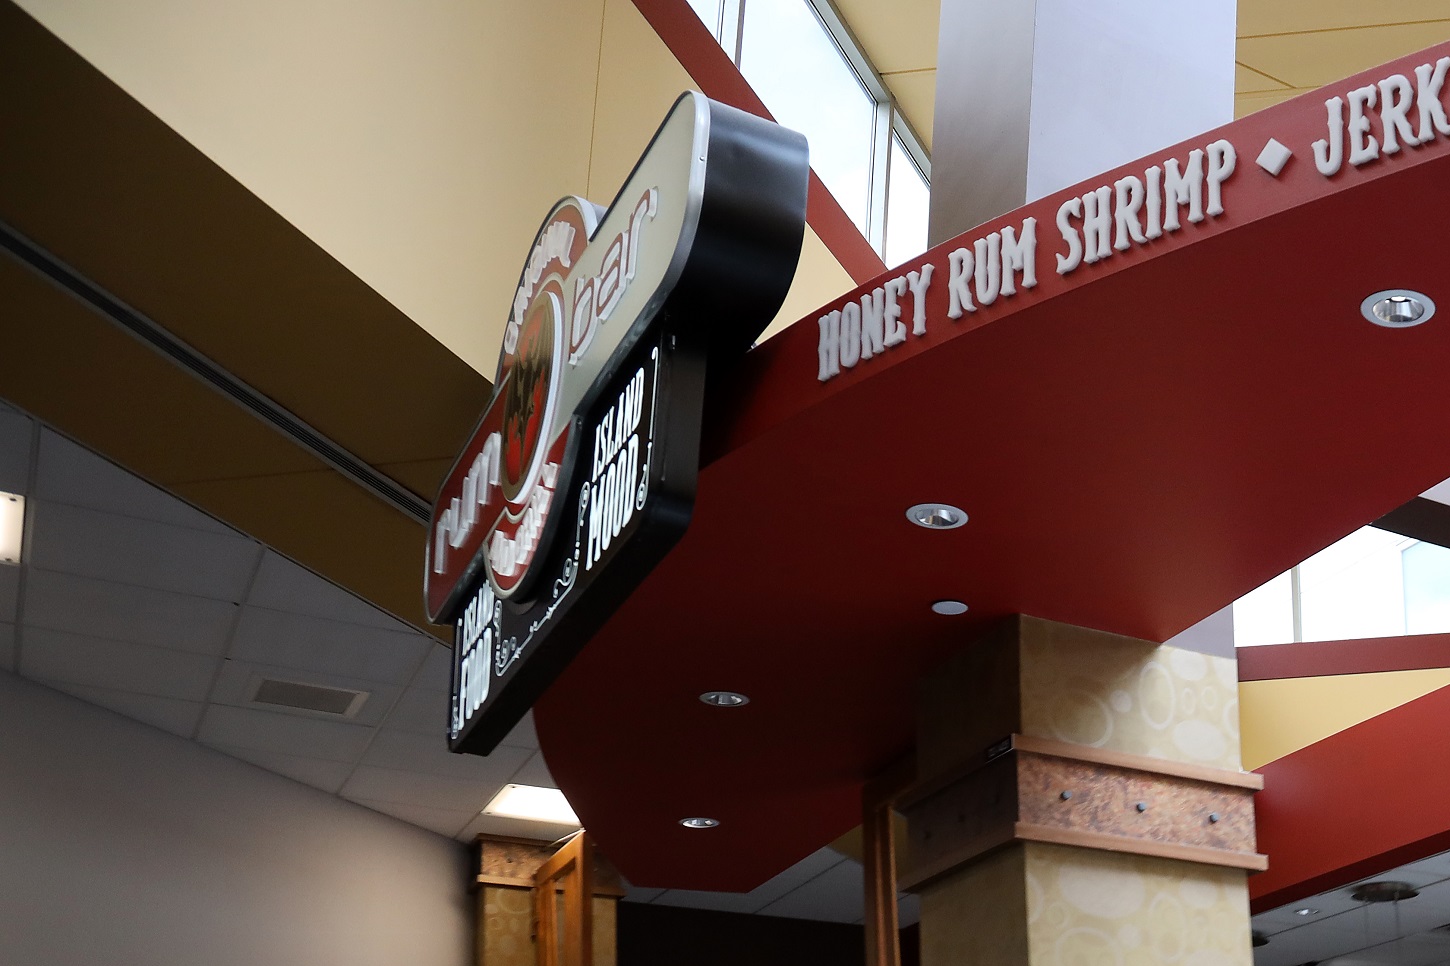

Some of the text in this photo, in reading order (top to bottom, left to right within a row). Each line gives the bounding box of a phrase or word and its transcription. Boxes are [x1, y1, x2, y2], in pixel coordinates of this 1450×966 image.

[815, 263, 935, 383] HONEY
[947, 216, 1038, 321] RUM
[1055, 138, 1237, 276] SHRIMP
[433, 186, 659, 575] rum bar
[592, 368, 645, 481] ISLAND
[586, 432, 641, 572] MOOD
[457, 626, 493, 731] FOOD
